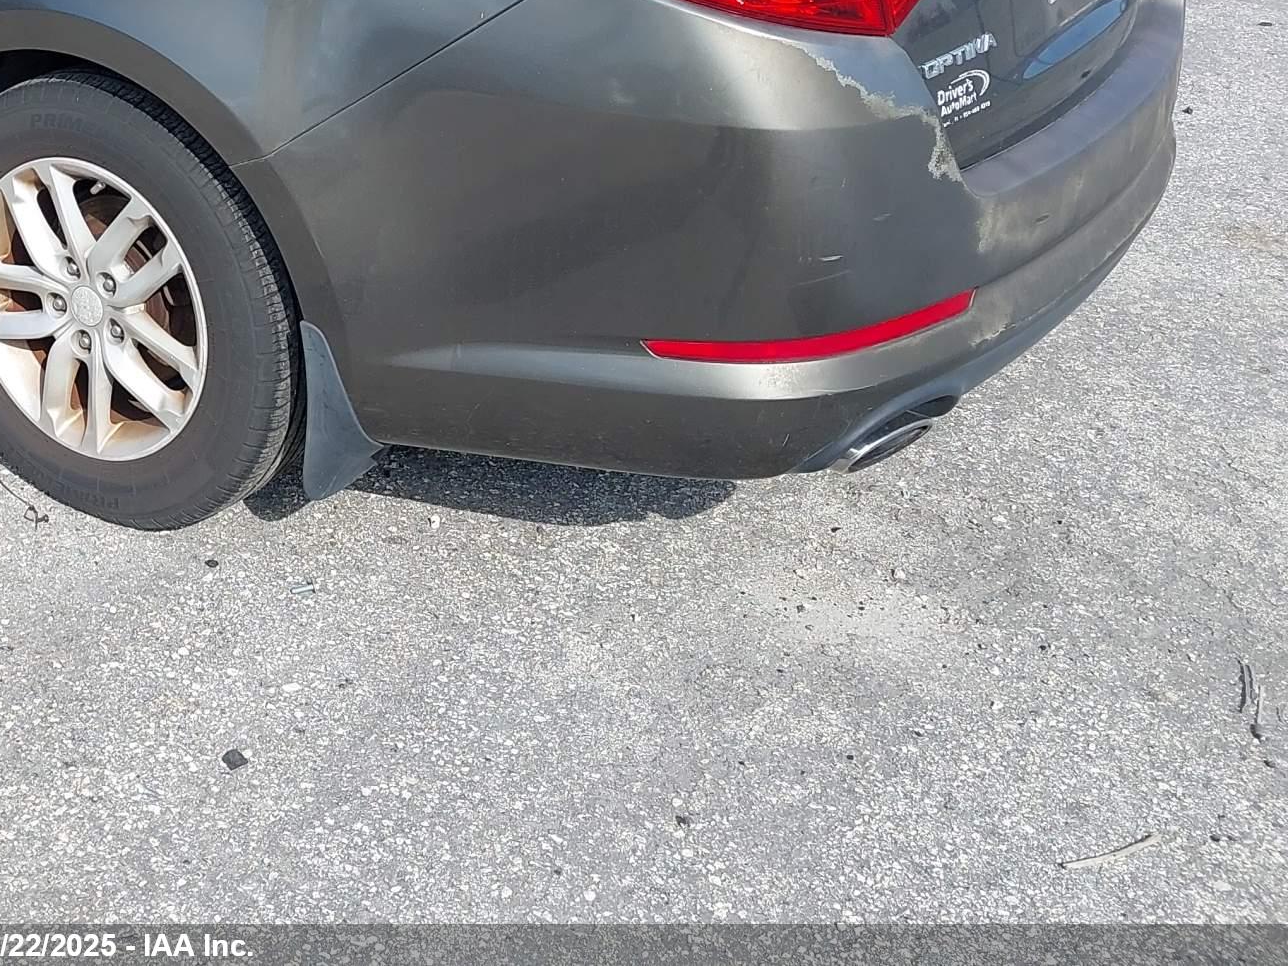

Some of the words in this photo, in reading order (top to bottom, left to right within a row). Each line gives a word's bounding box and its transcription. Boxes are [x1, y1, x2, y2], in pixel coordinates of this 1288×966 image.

[919, 32, 997, 79] OPTIMA
[937, 79, 974, 106] Driver's
[940, 92, 977, 117] AutoMart
